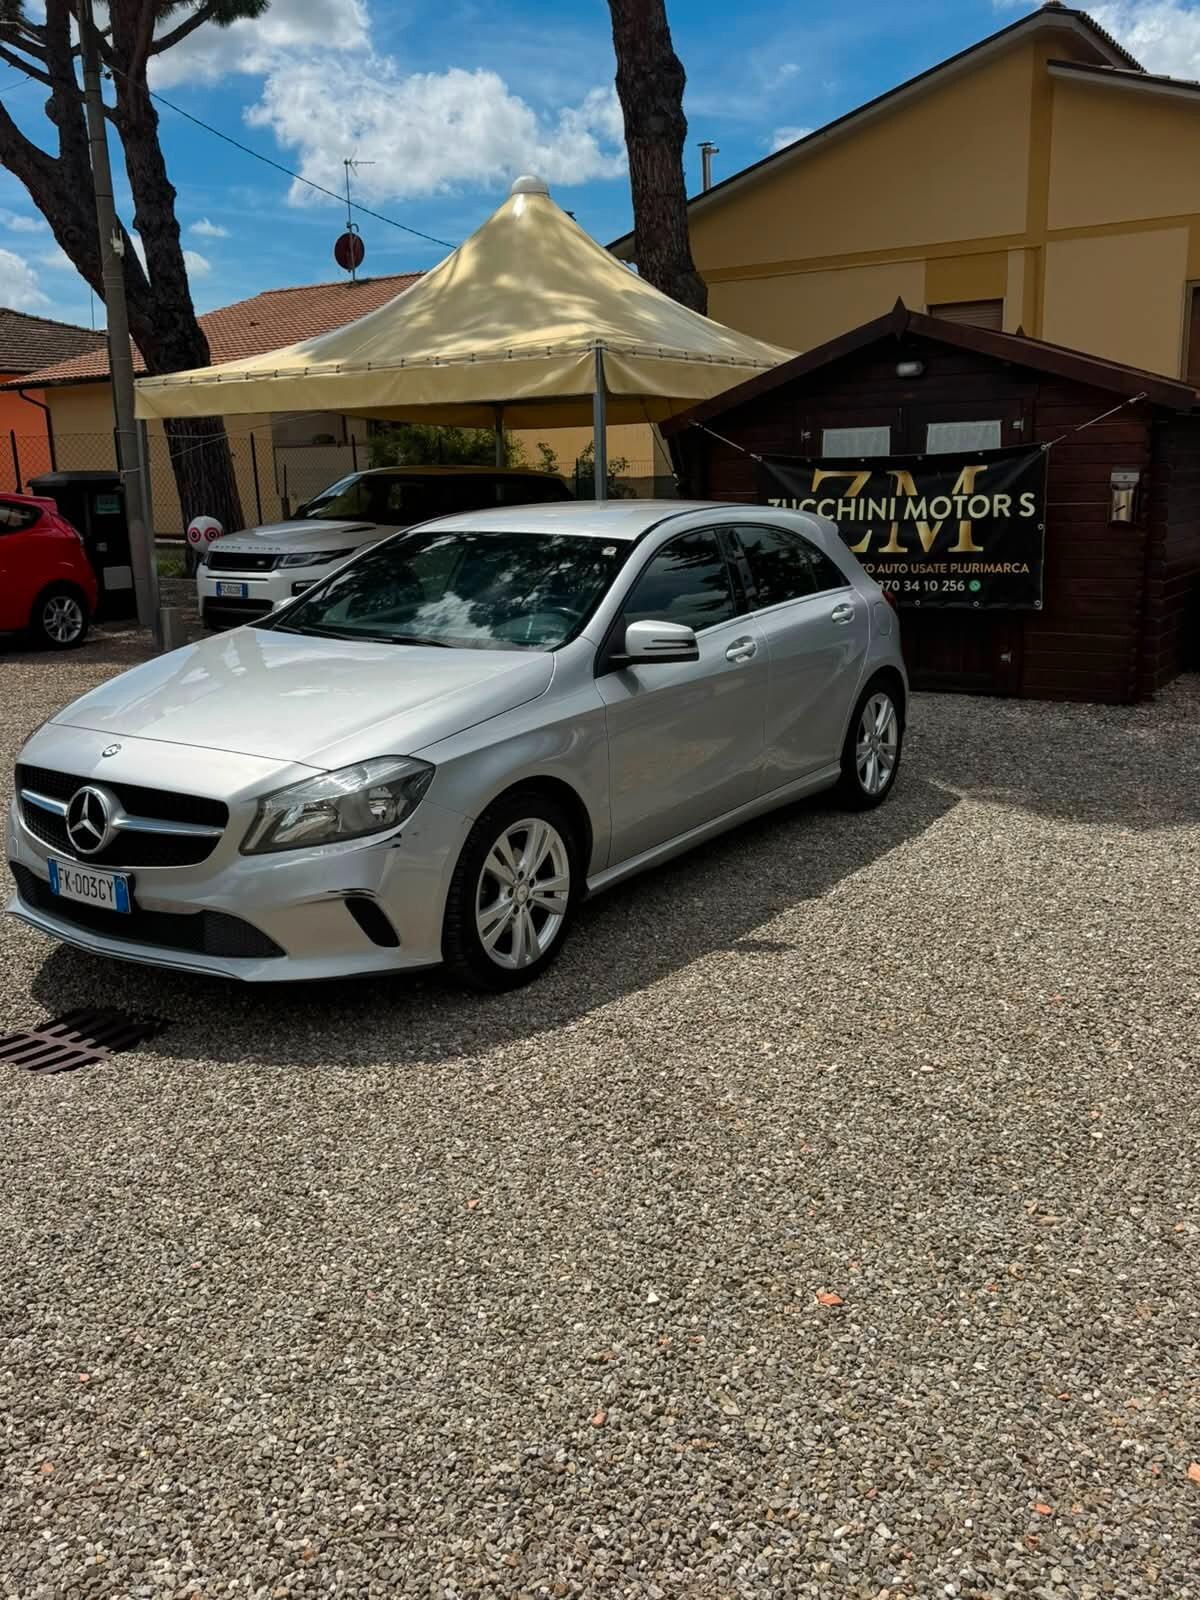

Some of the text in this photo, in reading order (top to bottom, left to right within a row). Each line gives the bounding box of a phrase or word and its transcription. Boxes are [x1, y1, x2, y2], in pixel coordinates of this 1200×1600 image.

[877, 563, 909, 574] AUTO
[911, 563, 947, 574] USATE
[950, 562, 1030, 574] PLURIMARCA
[904, 580, 920, 592] 34
[924, 580, 938, 592] 10
[942, 580, 965, 592] 256
